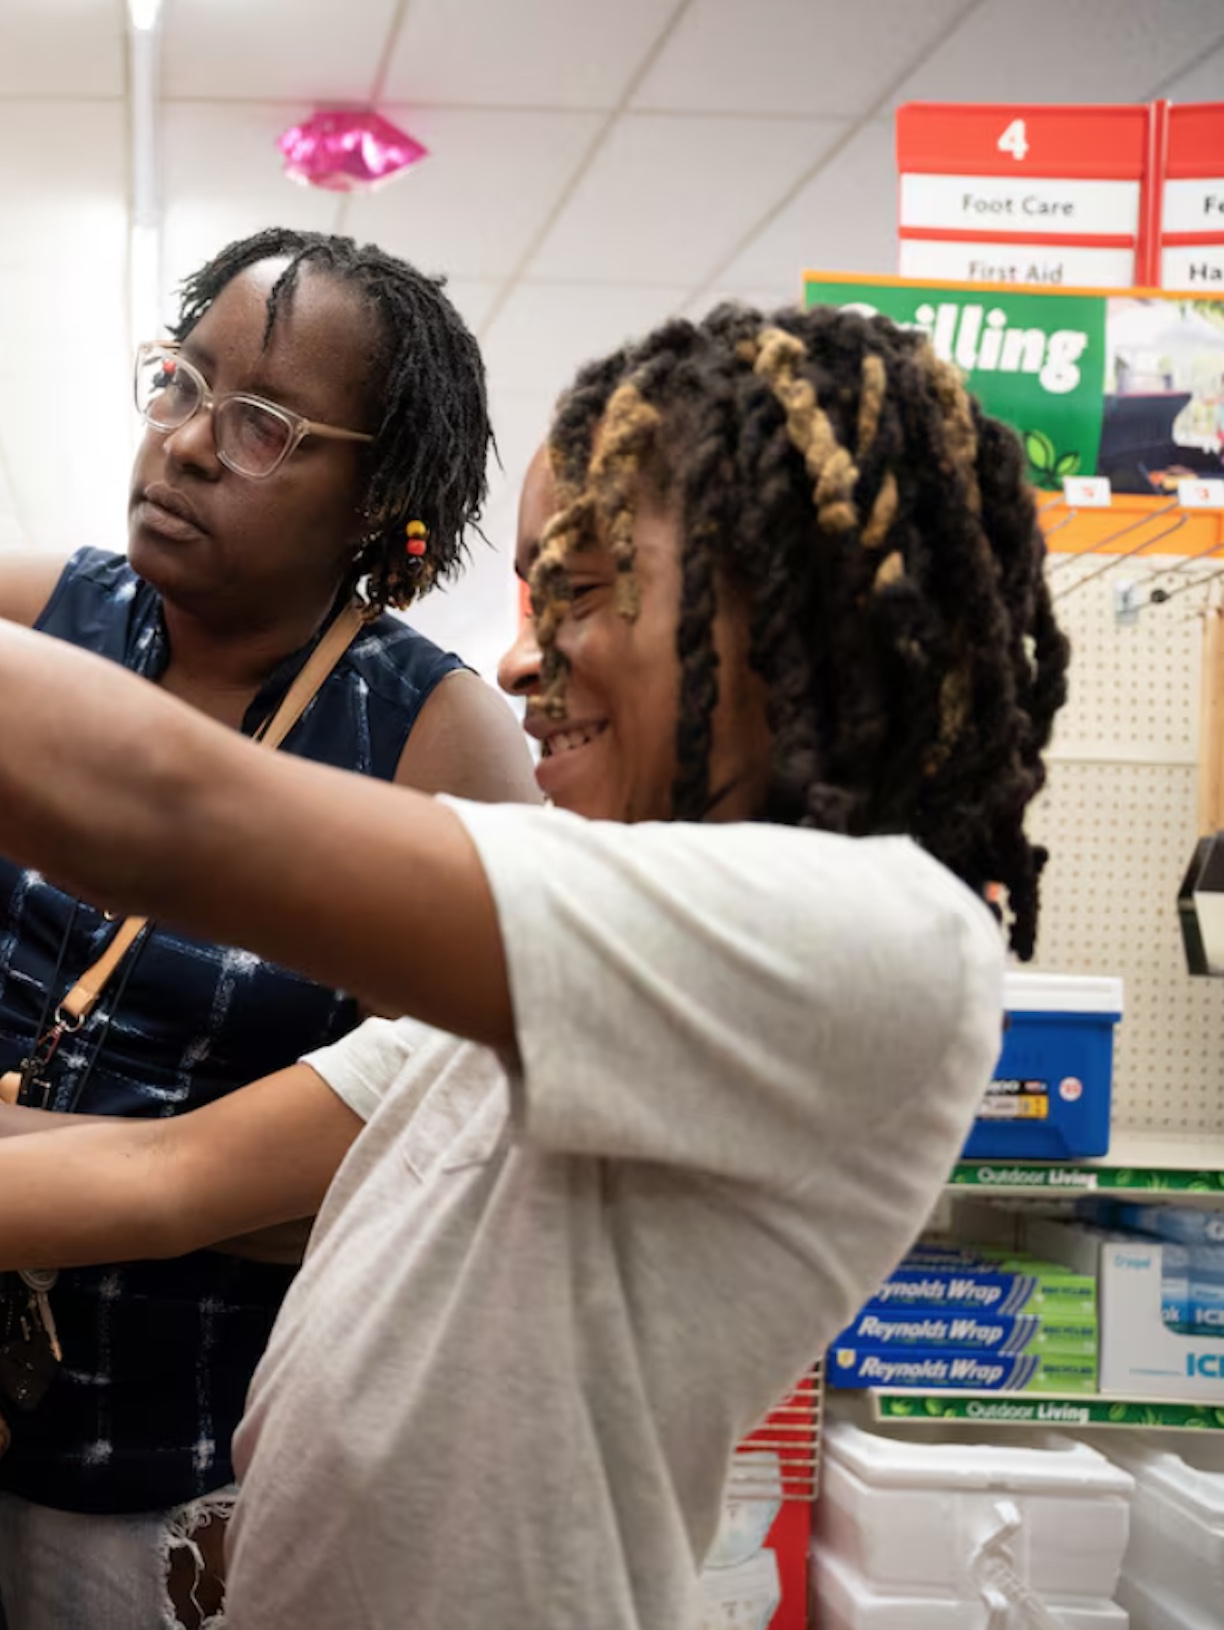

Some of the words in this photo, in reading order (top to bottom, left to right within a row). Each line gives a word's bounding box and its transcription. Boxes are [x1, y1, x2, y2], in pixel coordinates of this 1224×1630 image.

[997, 119, 1029, 160] 4
[962, 193, 1012, 212] Foot
[1022, 196, 1073, 215] Care
[969, 261, 1016, 279] First
[1027, 264, 1063, 283] Aid
[1189, 262, 1222, 280] Ha
[978, 1166, 1045, 1184] Outdoor
[1048, 1168, 1098, 1190] Living
[877, 1279, 946, 1302] ynolds
[947, 1278, 1003, 1305] Wrap
[857, 1316, 948, 1342] Reynolds
[949, 1318, 1004, 1346] Wrap
[858, 1356, 949, 1383] Reynolds
[950, 1358, 1004, 1386] Wrap
[966, 1400, 1033, 1419] Outdoor
[1037, 1401, 1090, 1425] Living
